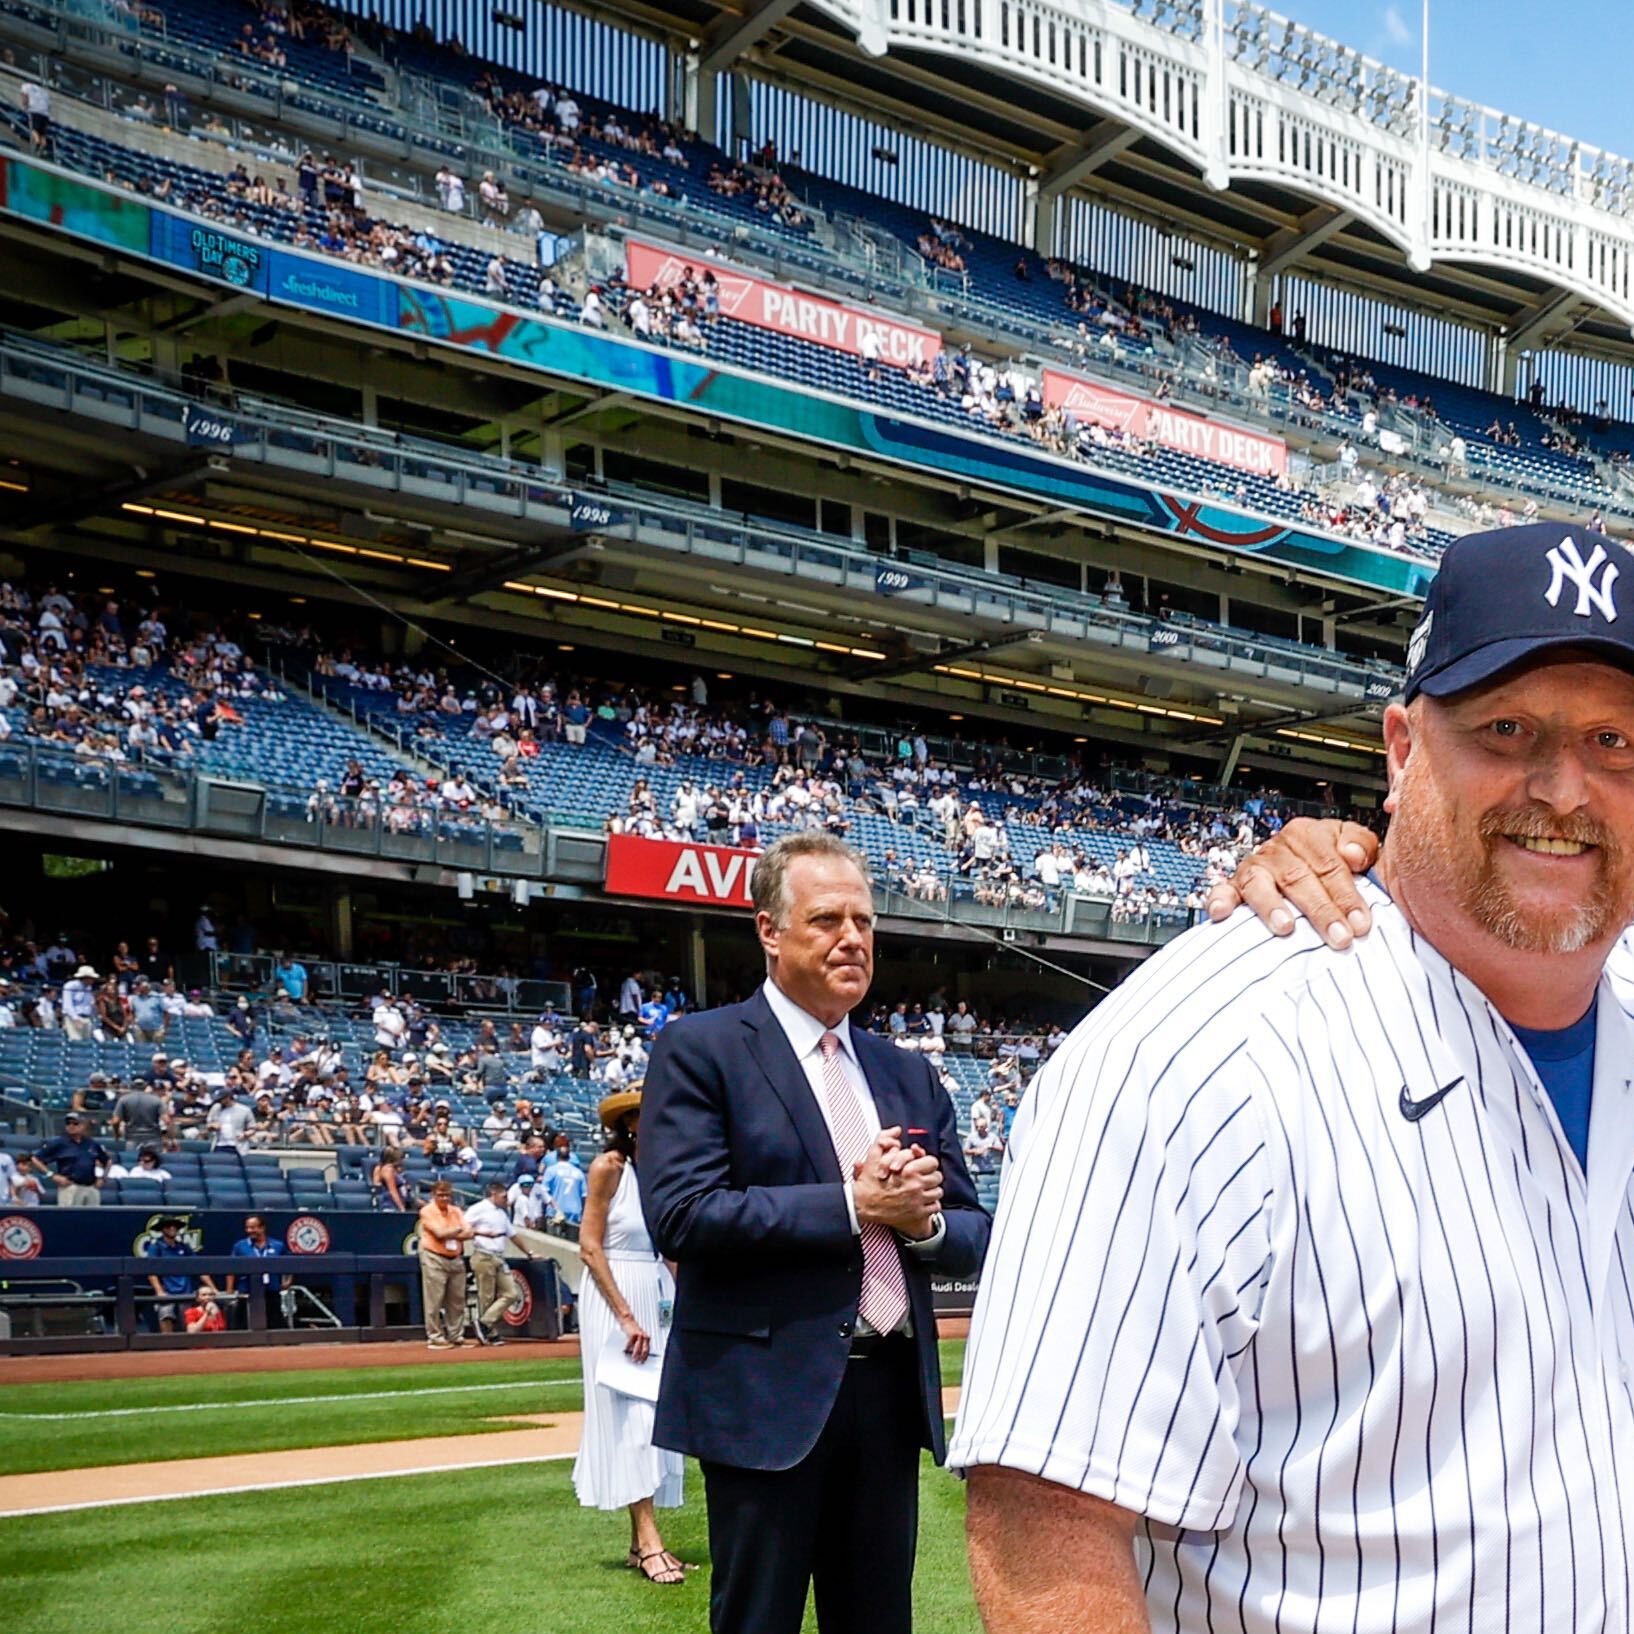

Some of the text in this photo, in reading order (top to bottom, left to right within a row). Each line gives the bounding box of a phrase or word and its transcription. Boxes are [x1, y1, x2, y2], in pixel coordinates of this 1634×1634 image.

[282, 275, 358, 307] freshdirect
[762, 287, 849, 343] PARTY
[189, 418, 233, 441] 1996
[1219, 429, 1273, 469] DECK
[572, 504, 610, 524] 1998
[877, 570, 909, 588] 1999
[1544, 536, 1620, 624] NY
[1151, 631, 1179, 646] 2000
[1366, 682, 1392, 698] 2009
[931, 1281, 953, 1293] Audi
